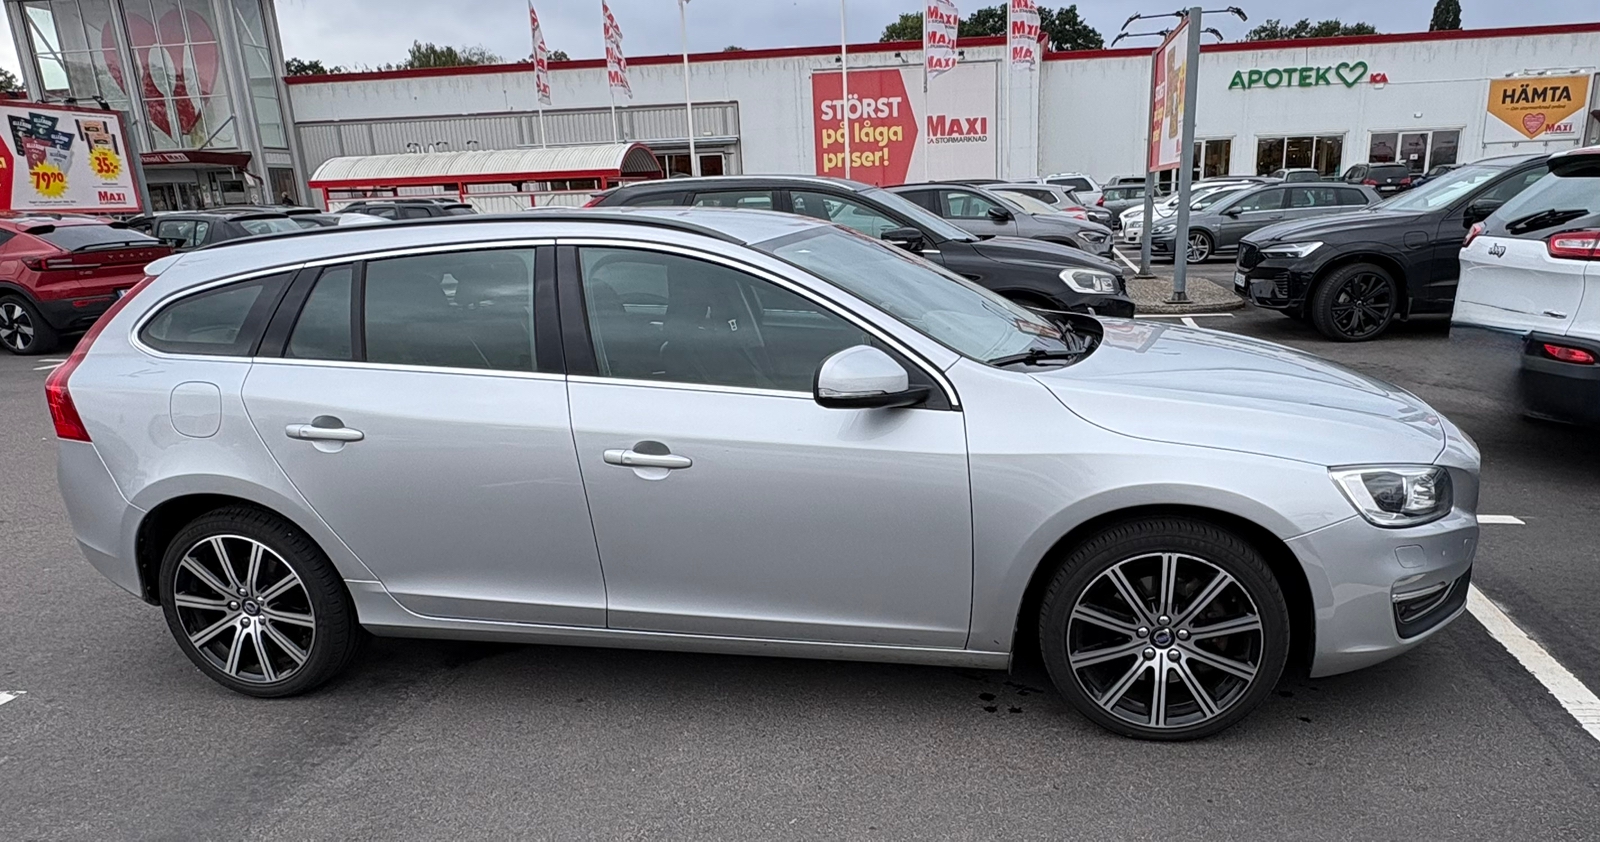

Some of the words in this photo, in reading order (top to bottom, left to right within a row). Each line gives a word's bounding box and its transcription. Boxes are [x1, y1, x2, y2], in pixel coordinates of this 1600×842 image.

[927, 5, 957, 25] MAXI
[1228, 66, 1332, 91] APOTEK
[1370, 73, 1388, 83] ICA
[1501, 84, 1572, 104] HÄMTA
[821, 94, 901, 121] STÖRST
[822, 121, 845, 149] på
[854, 120, 903, 147] låga
[927, 115, 987, 136] MAXI
[1545, 123, 1572, 132] MAXI
[935, 135, 987, 144] STORMARKNAD
[823, 148, 889, 172] prser!
[98, 191, 126, 202] MAXI
